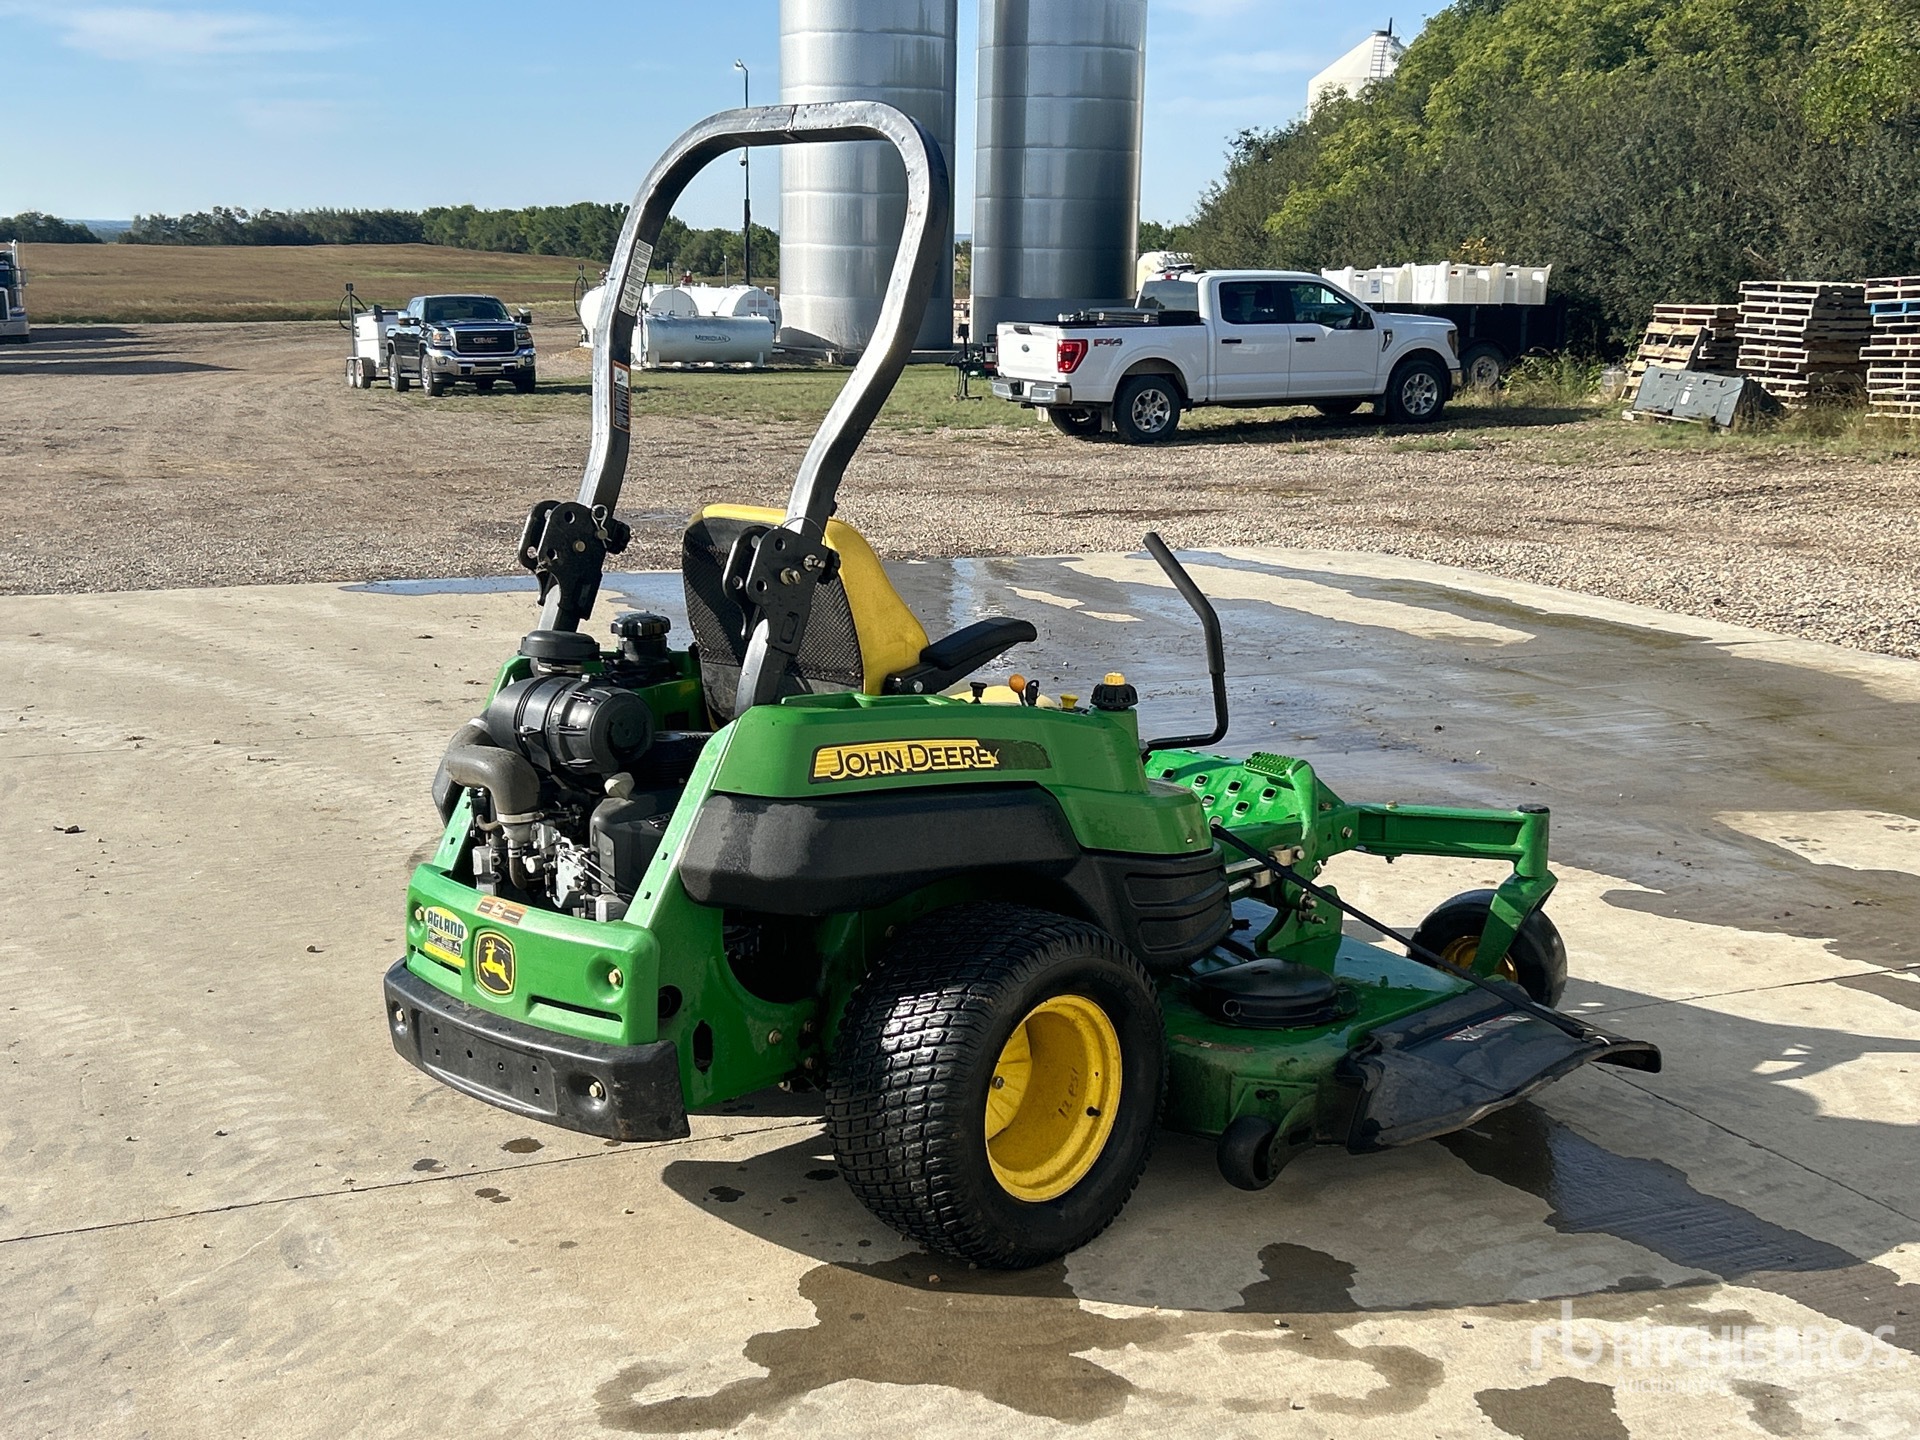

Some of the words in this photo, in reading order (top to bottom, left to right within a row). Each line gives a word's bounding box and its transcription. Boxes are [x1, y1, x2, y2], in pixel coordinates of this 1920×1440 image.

[694, 334, 728, 342] MERIDIAN
[1093, 338, 1123, 346] FX4
[829, 749, 902, 778] JOHN
[906, 743, 994, 769] DEERE
[427, 910, 465, 940] AGLAND
